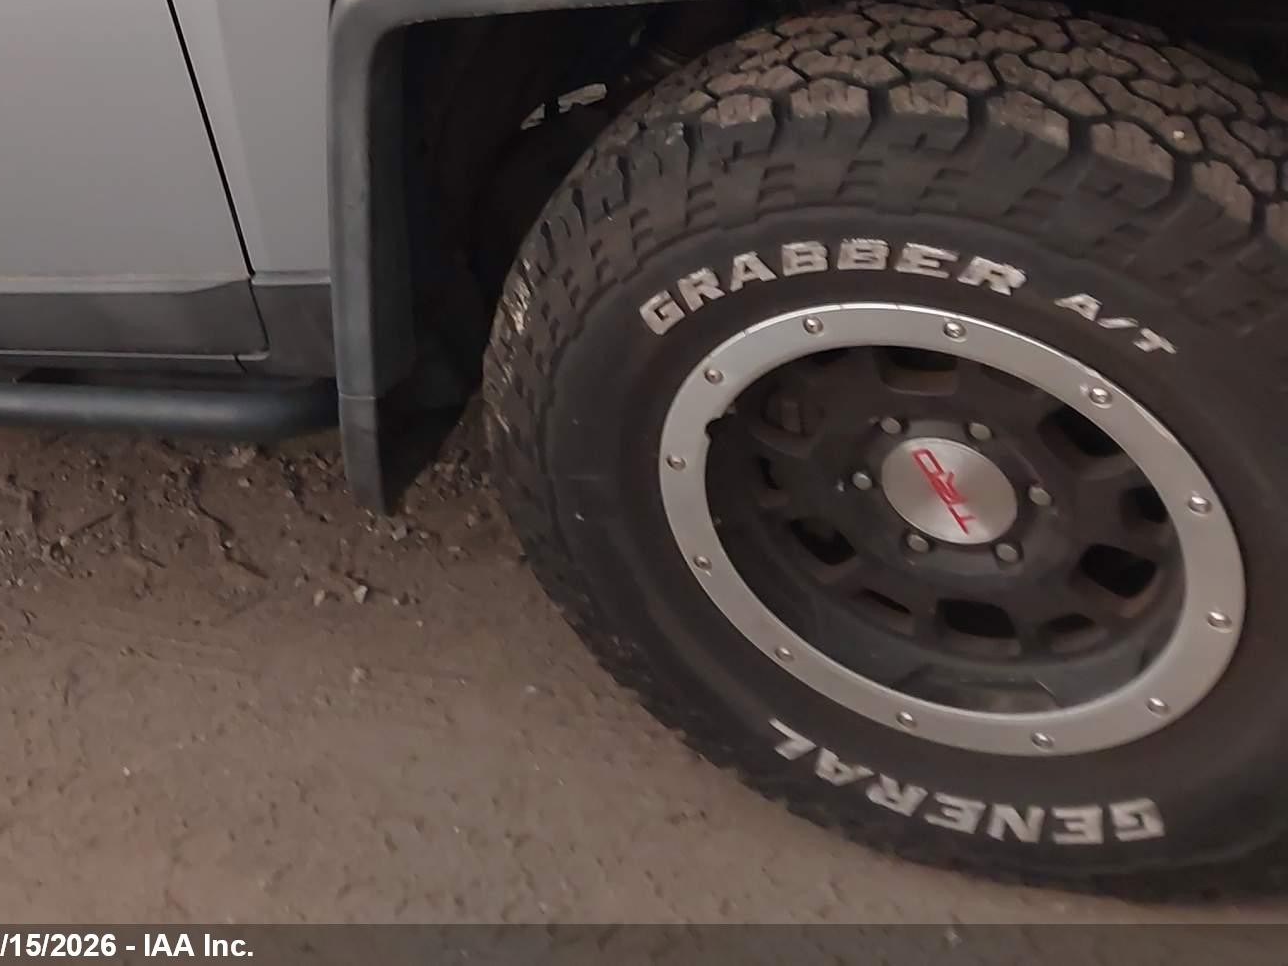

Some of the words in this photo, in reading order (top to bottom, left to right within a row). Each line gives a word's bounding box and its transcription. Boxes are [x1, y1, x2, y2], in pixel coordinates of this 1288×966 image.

[639, 237, 1027, 334] GRABBER
[1054, 293, 1176, 354] A/T
[912, 448, 975, 535] TRD
[768, 718, 1165, 845] GENERAL
